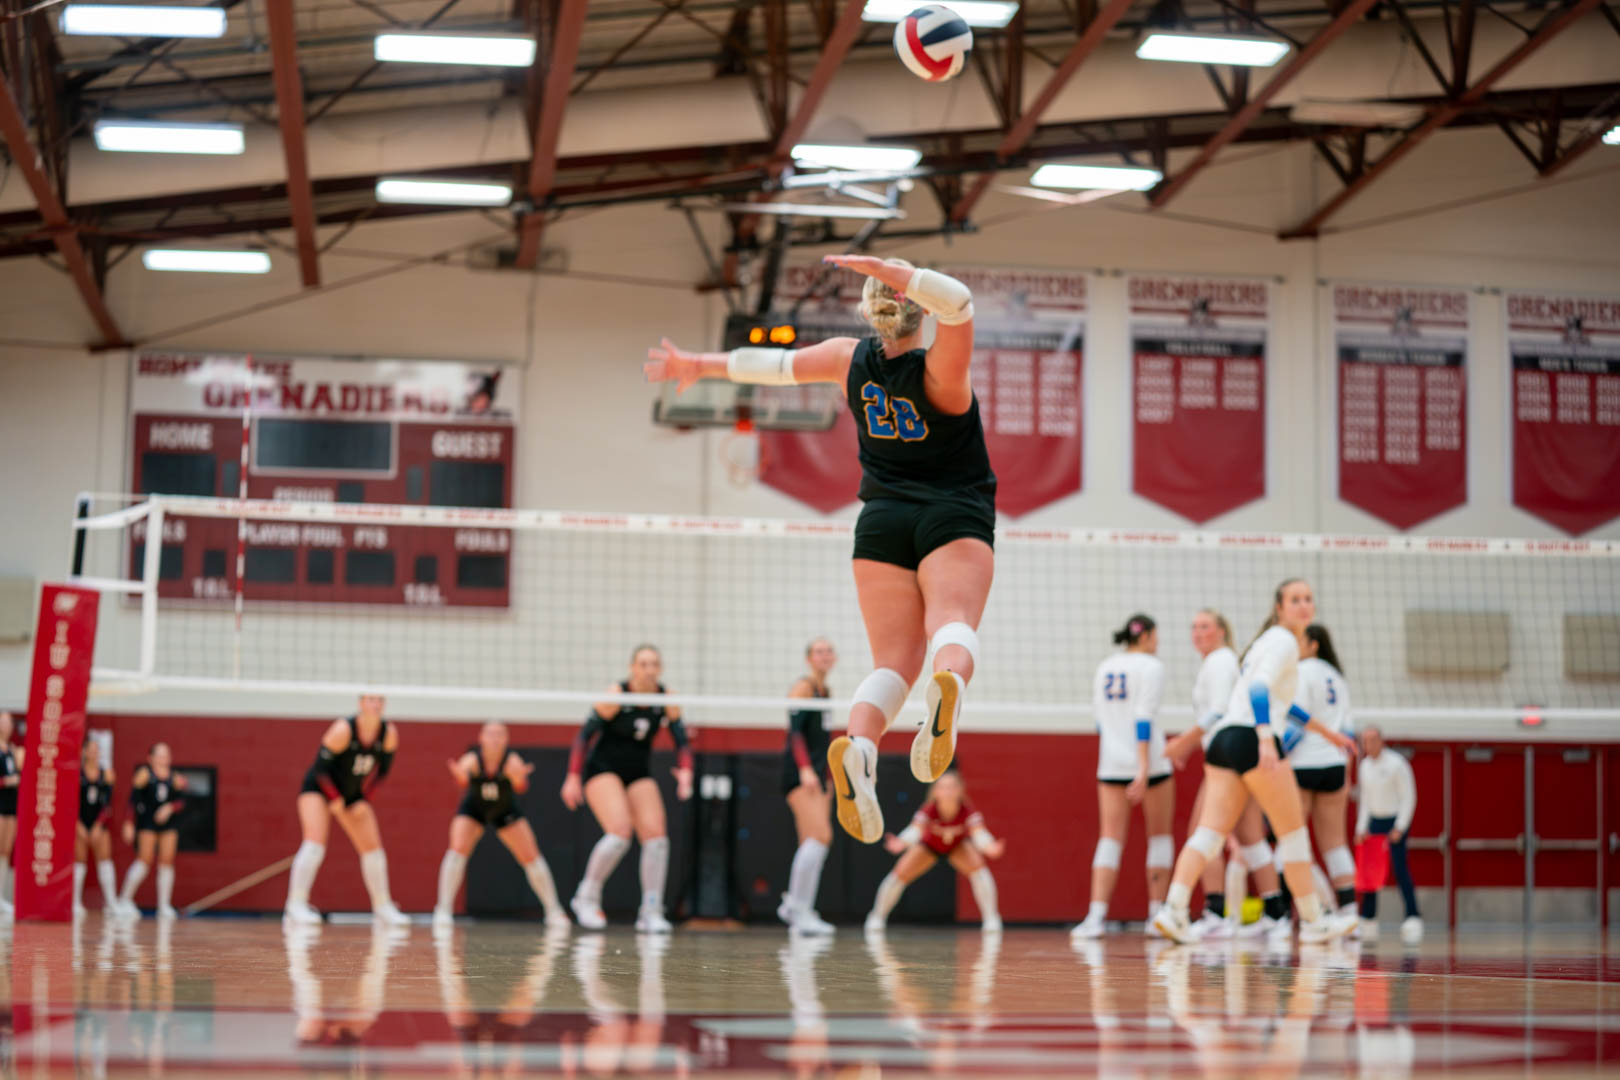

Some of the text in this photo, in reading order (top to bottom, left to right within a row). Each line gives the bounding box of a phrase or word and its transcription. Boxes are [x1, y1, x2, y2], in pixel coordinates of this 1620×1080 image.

[861, 381, 929, 442] 28
[150, 422, 213, 449] HOME
[432, 430, 502, 459] GUEST
